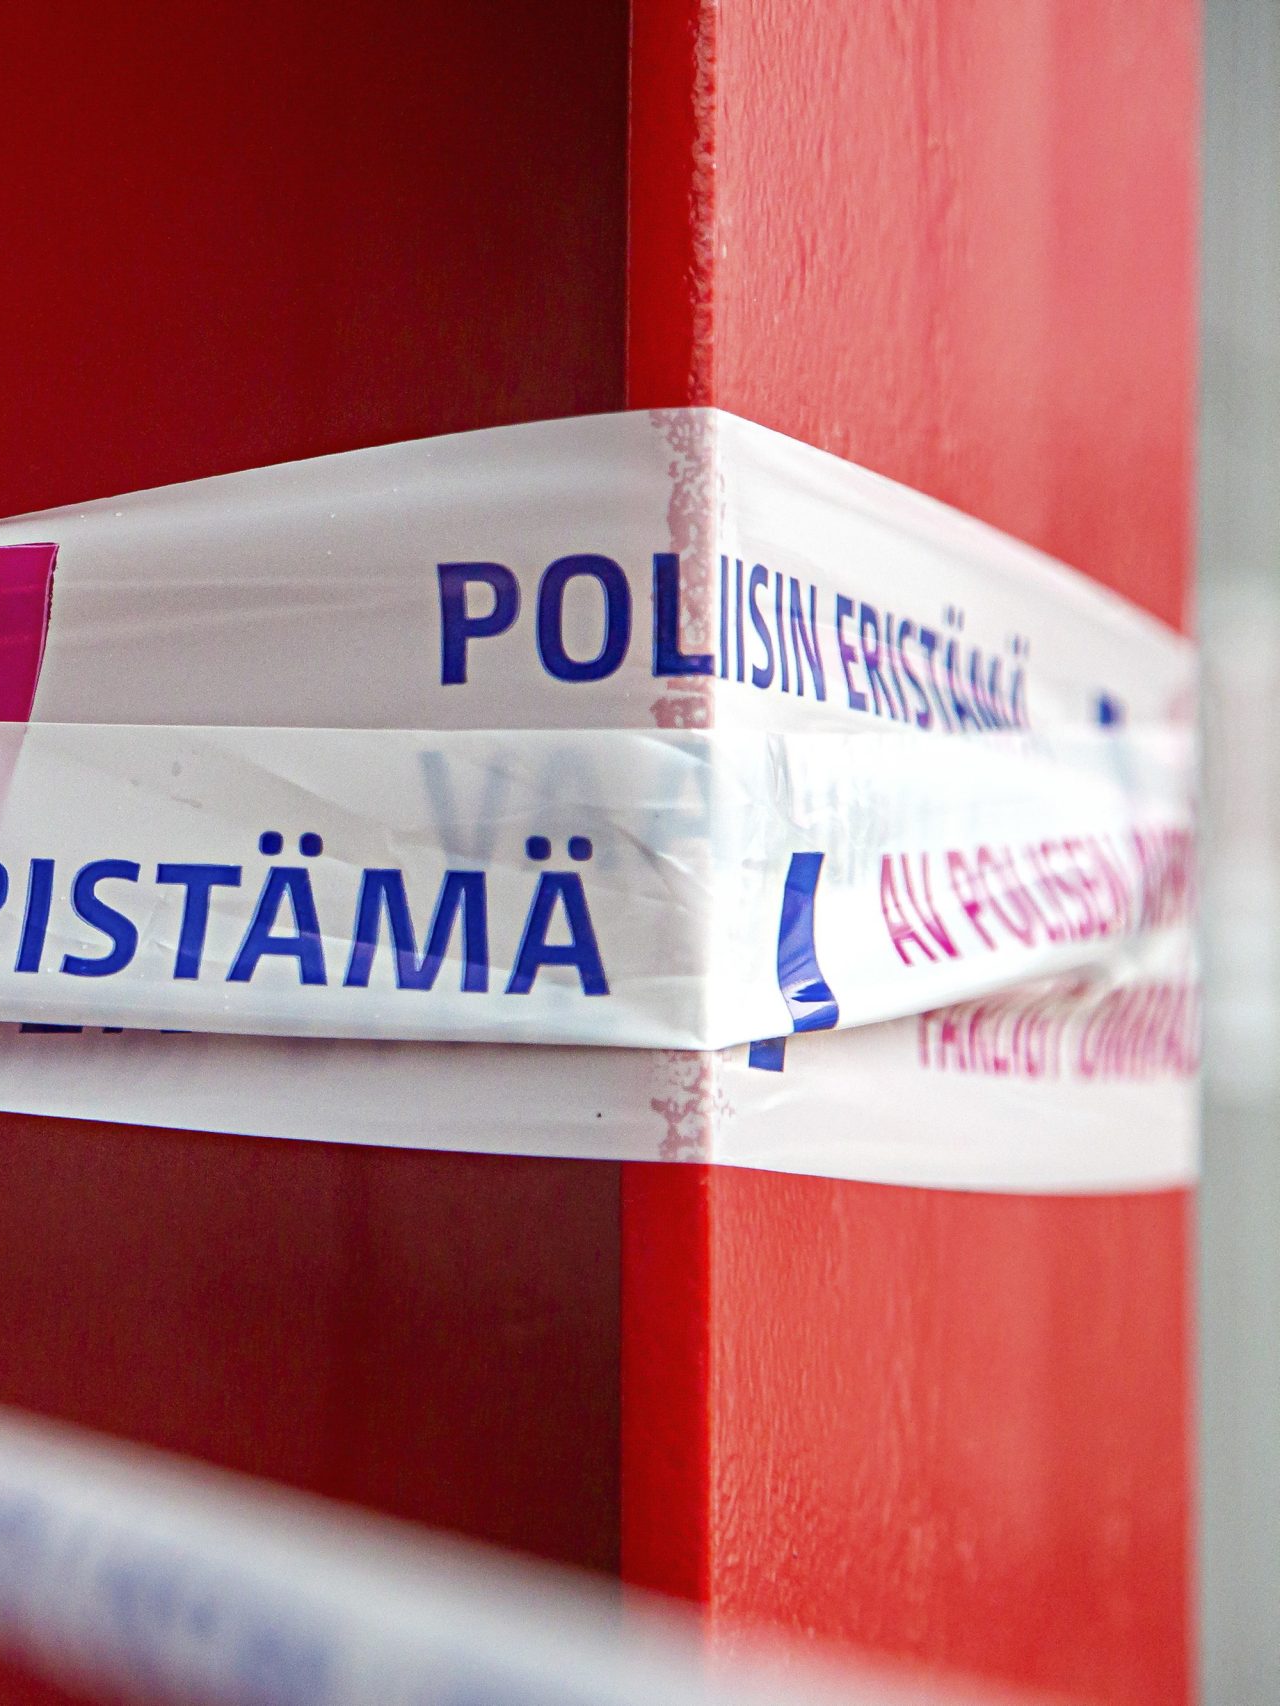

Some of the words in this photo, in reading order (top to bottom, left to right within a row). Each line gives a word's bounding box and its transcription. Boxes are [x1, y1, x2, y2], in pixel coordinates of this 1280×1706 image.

[436, 552, 828, 702] POLIISIN
[835, 592, 1032, 733] ERISTÄMÄ
[880, 853, 962, 967] AV
